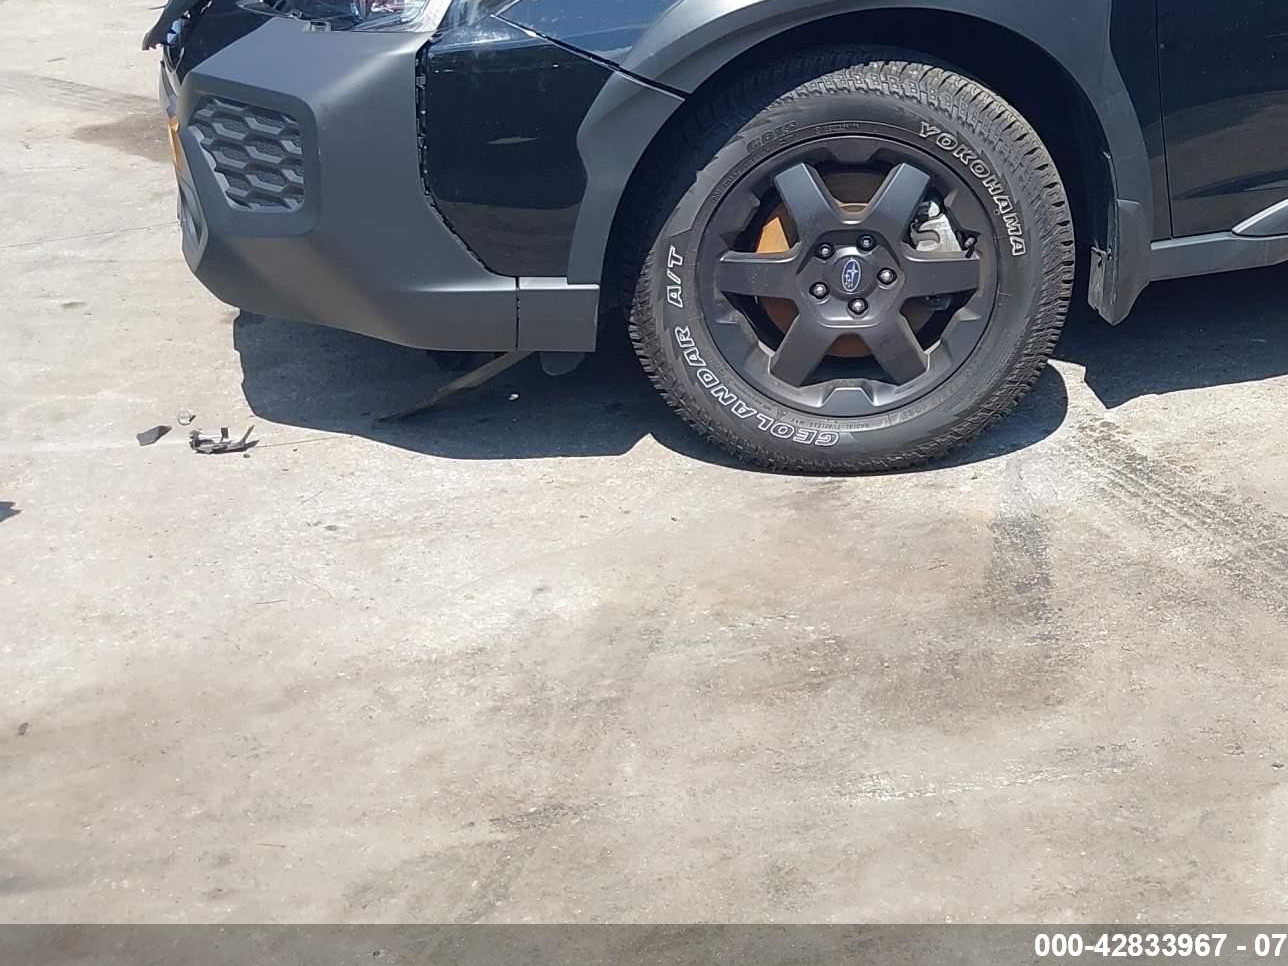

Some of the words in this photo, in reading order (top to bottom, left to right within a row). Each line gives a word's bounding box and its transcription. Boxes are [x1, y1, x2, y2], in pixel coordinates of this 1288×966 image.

[919, 121, 1026, 256] YOKOHAMA
[667, 245, 684, 308] A/T
[674, 325, 840, 447] GEOLANDAR
